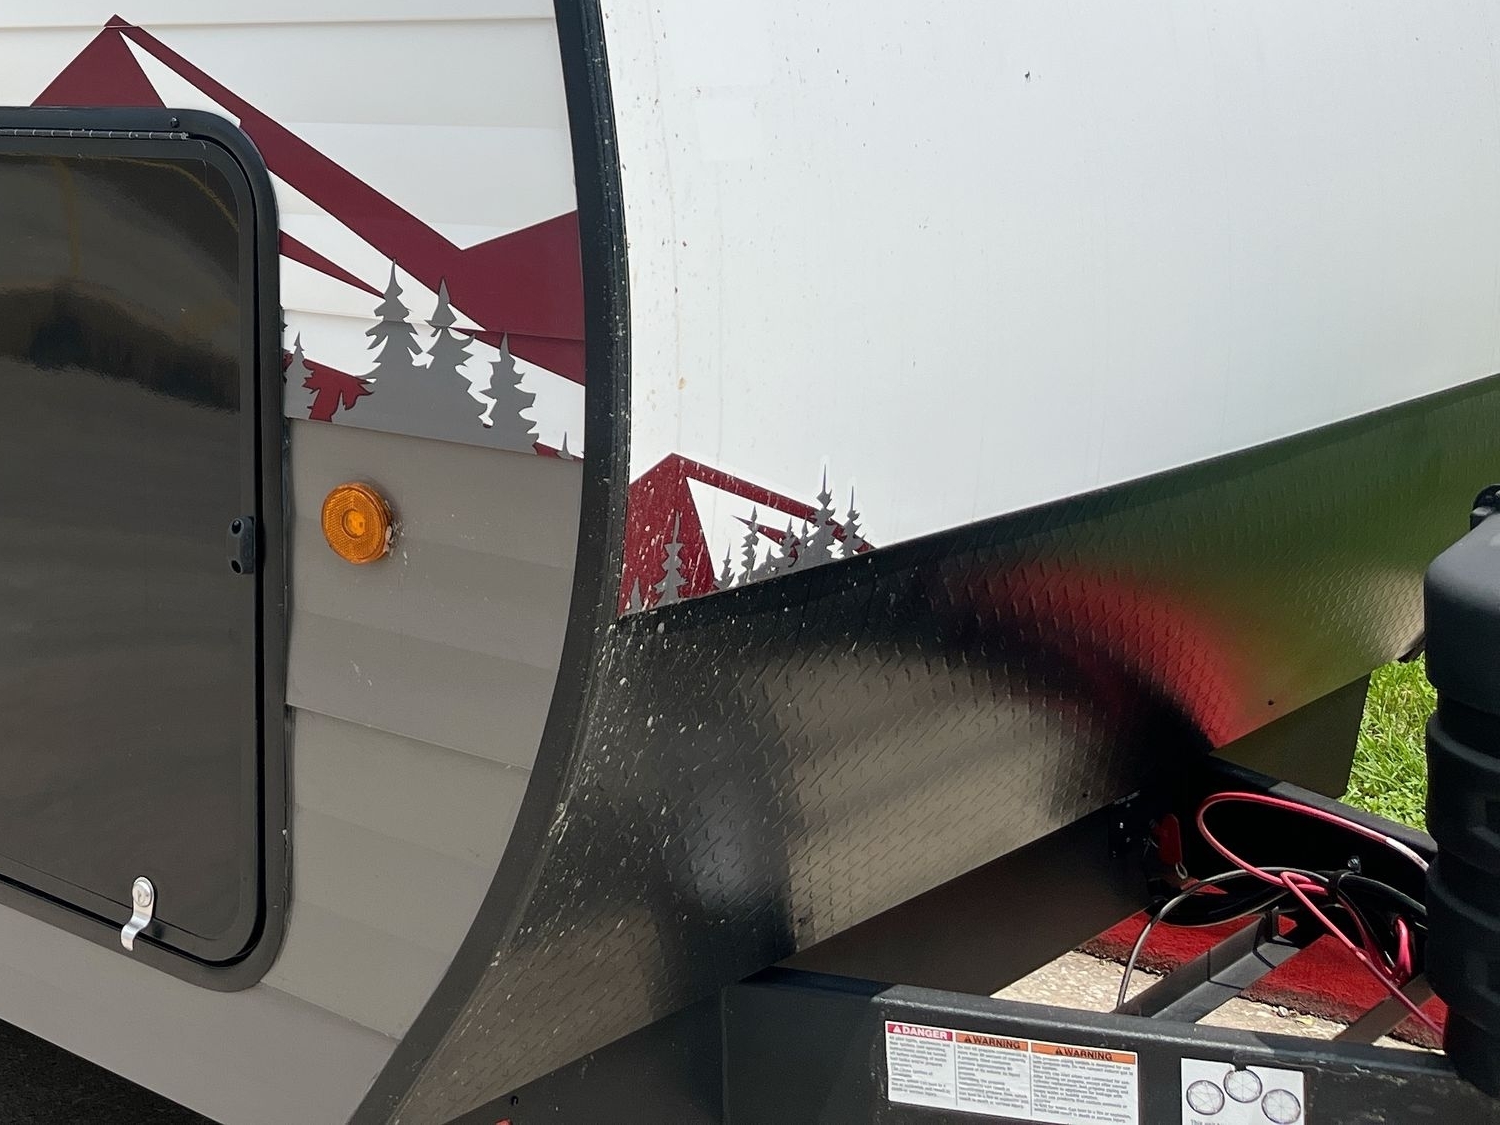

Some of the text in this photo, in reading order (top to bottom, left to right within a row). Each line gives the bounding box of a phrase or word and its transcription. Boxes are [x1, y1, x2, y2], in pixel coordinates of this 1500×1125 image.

[902, 1025, 948, 1040] DANGER
[973, 1035, 1021, 1050] WARNING
[1063, 1048, 1113, 1061] WARNING
